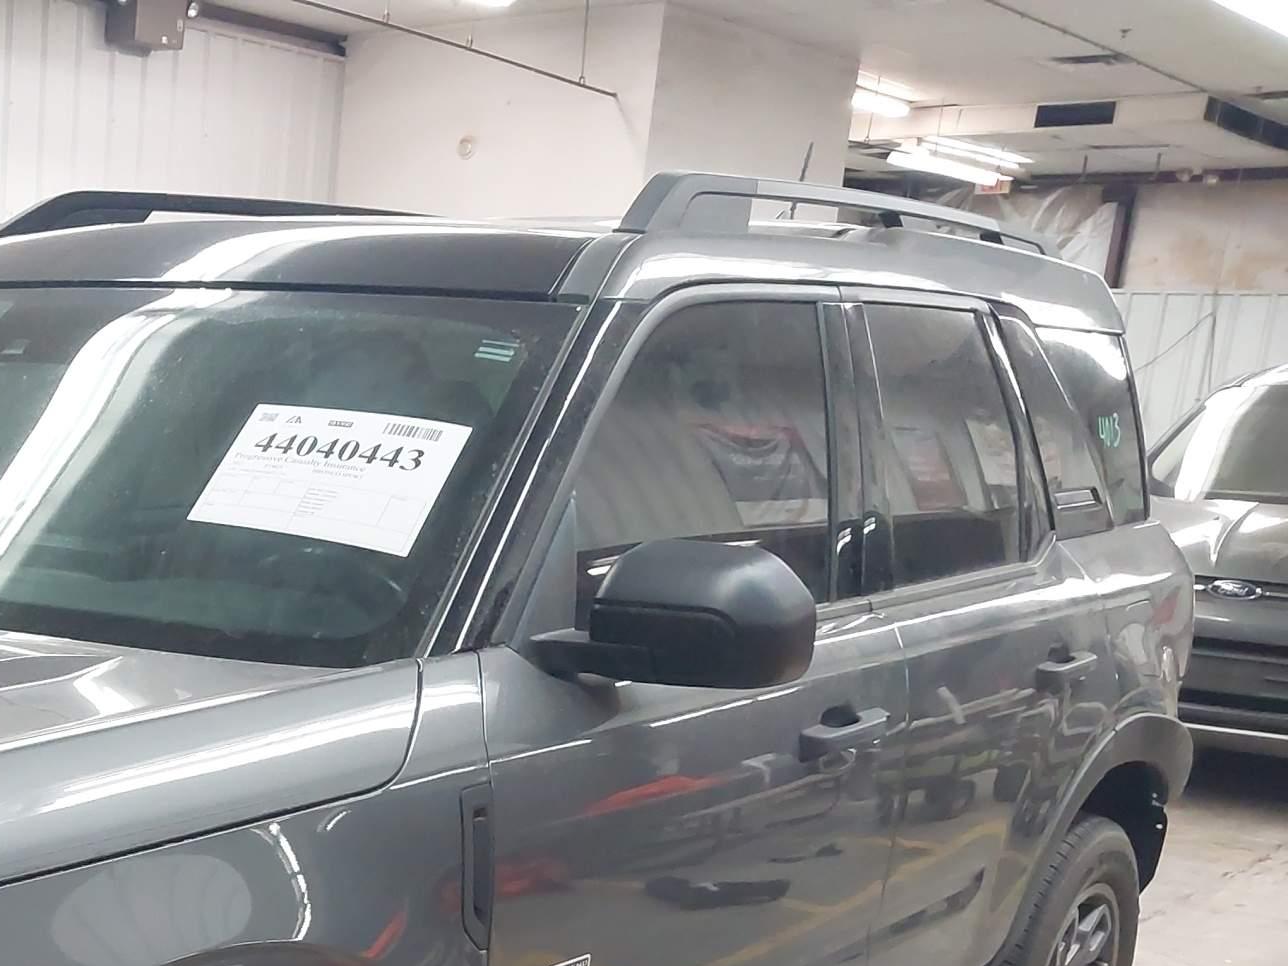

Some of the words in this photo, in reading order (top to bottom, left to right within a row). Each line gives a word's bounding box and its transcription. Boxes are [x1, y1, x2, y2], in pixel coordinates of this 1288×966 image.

[254, 432, 425, 471] 44040443
[284, 455, 320, 468] Casualty
[323, 460, 367, 472] Insurance
